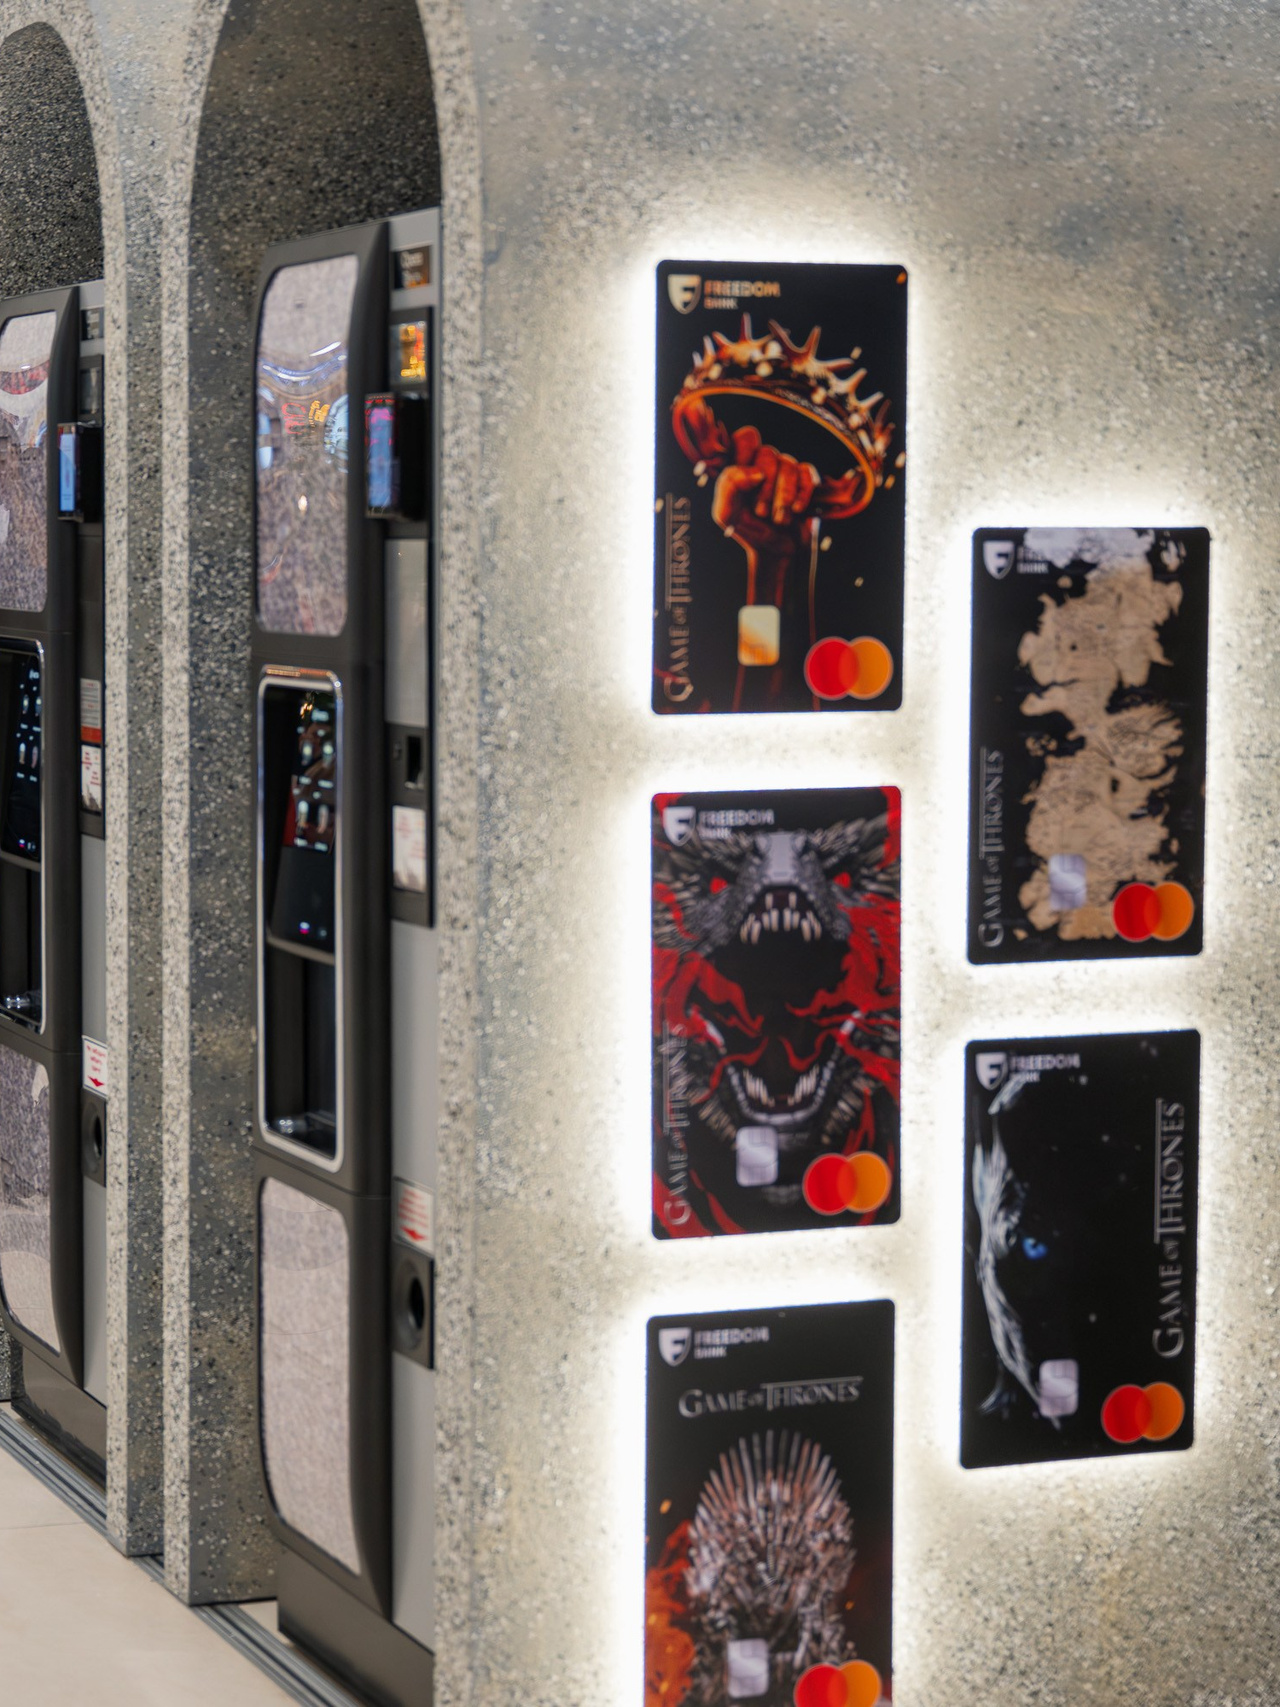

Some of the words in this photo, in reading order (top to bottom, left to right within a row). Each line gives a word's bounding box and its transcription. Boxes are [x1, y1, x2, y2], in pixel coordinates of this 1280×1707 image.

[978, 746, 1005, 860] THRONES
[978, 875, 1005, 947] GAME
[1153, 1097, 1187, 1245] THRONES
[1152, 1264, 1185, 1359] GAME
[678, 1389, 748, 1418] GAME
[760, 1376, 864, 1412] THRONES
